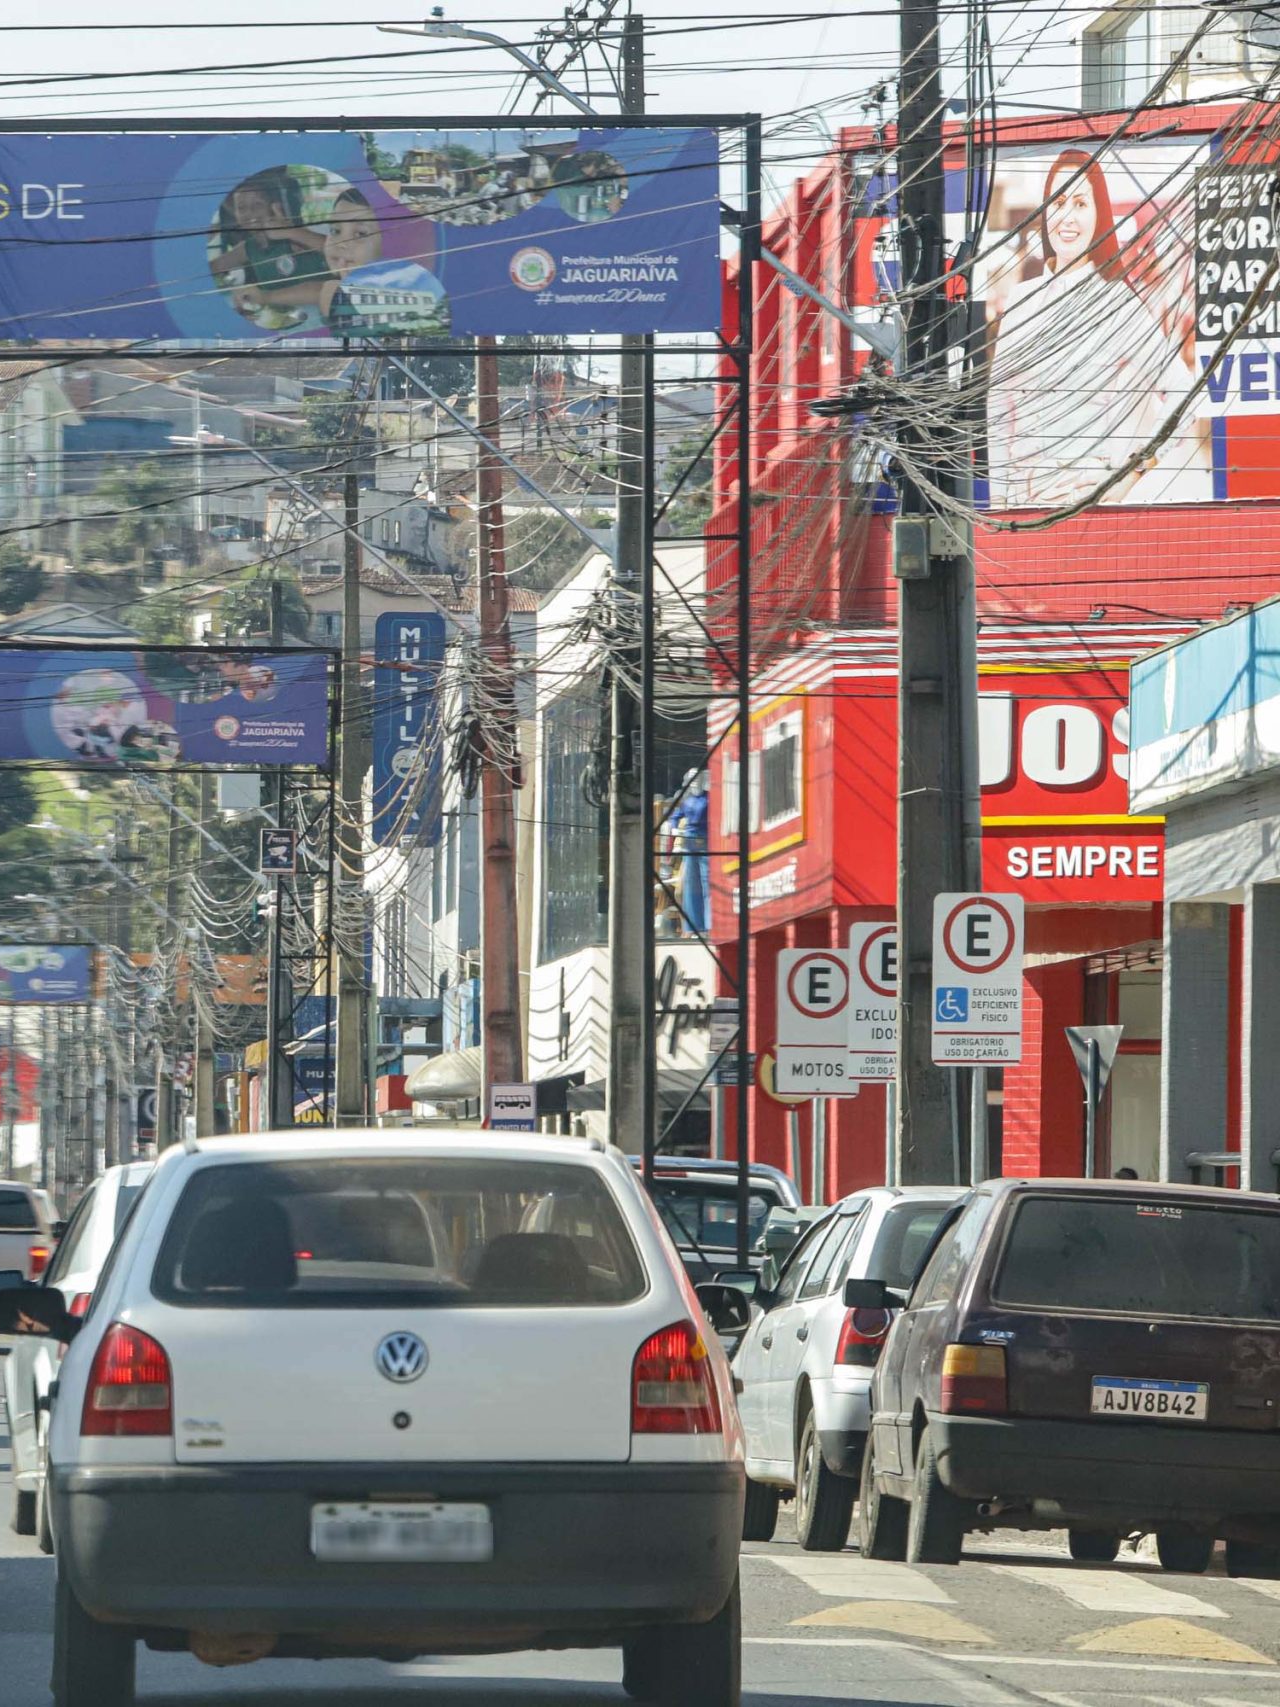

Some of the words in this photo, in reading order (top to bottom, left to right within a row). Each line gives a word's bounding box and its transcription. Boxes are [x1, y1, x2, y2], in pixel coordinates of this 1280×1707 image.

[1198, 173, 1277, 209] FEIT
[21, 183, 85, 220] DE
[664, 255, 679, 265] de
[561, 265, 679, 283] JAGUARIAÍVA
[1198, 301, 1280, 337] COM
[1200, 351, 1280, 403] VE
[1007, 846, 1160, 877] SEMPRE
[967, 914, 992, 957] E
[808, 967, 831, 1004] E
[972, 988, 1018, 997] EXCLUSIVO
[971, 1001, 1019, 1010] DEFICIENTE
[855, 1009, 897, 1022] EXCLU
[981, 1012, 1009, 1022] FÍSICO
[950, 1037, 1004, 1046] OBRIGATÓRIO
[945, 1049, 961, 1057] USO
[963, 1049, 975, 1057] DO
[976, 1047, 1010, 1058] CARTÃO
[865, 1057, 897, 1066] OBRIGAT
[791, 1063, 844, 1077] MOTOS
[1103, 1390, 1197, 1415] AJV8B42
